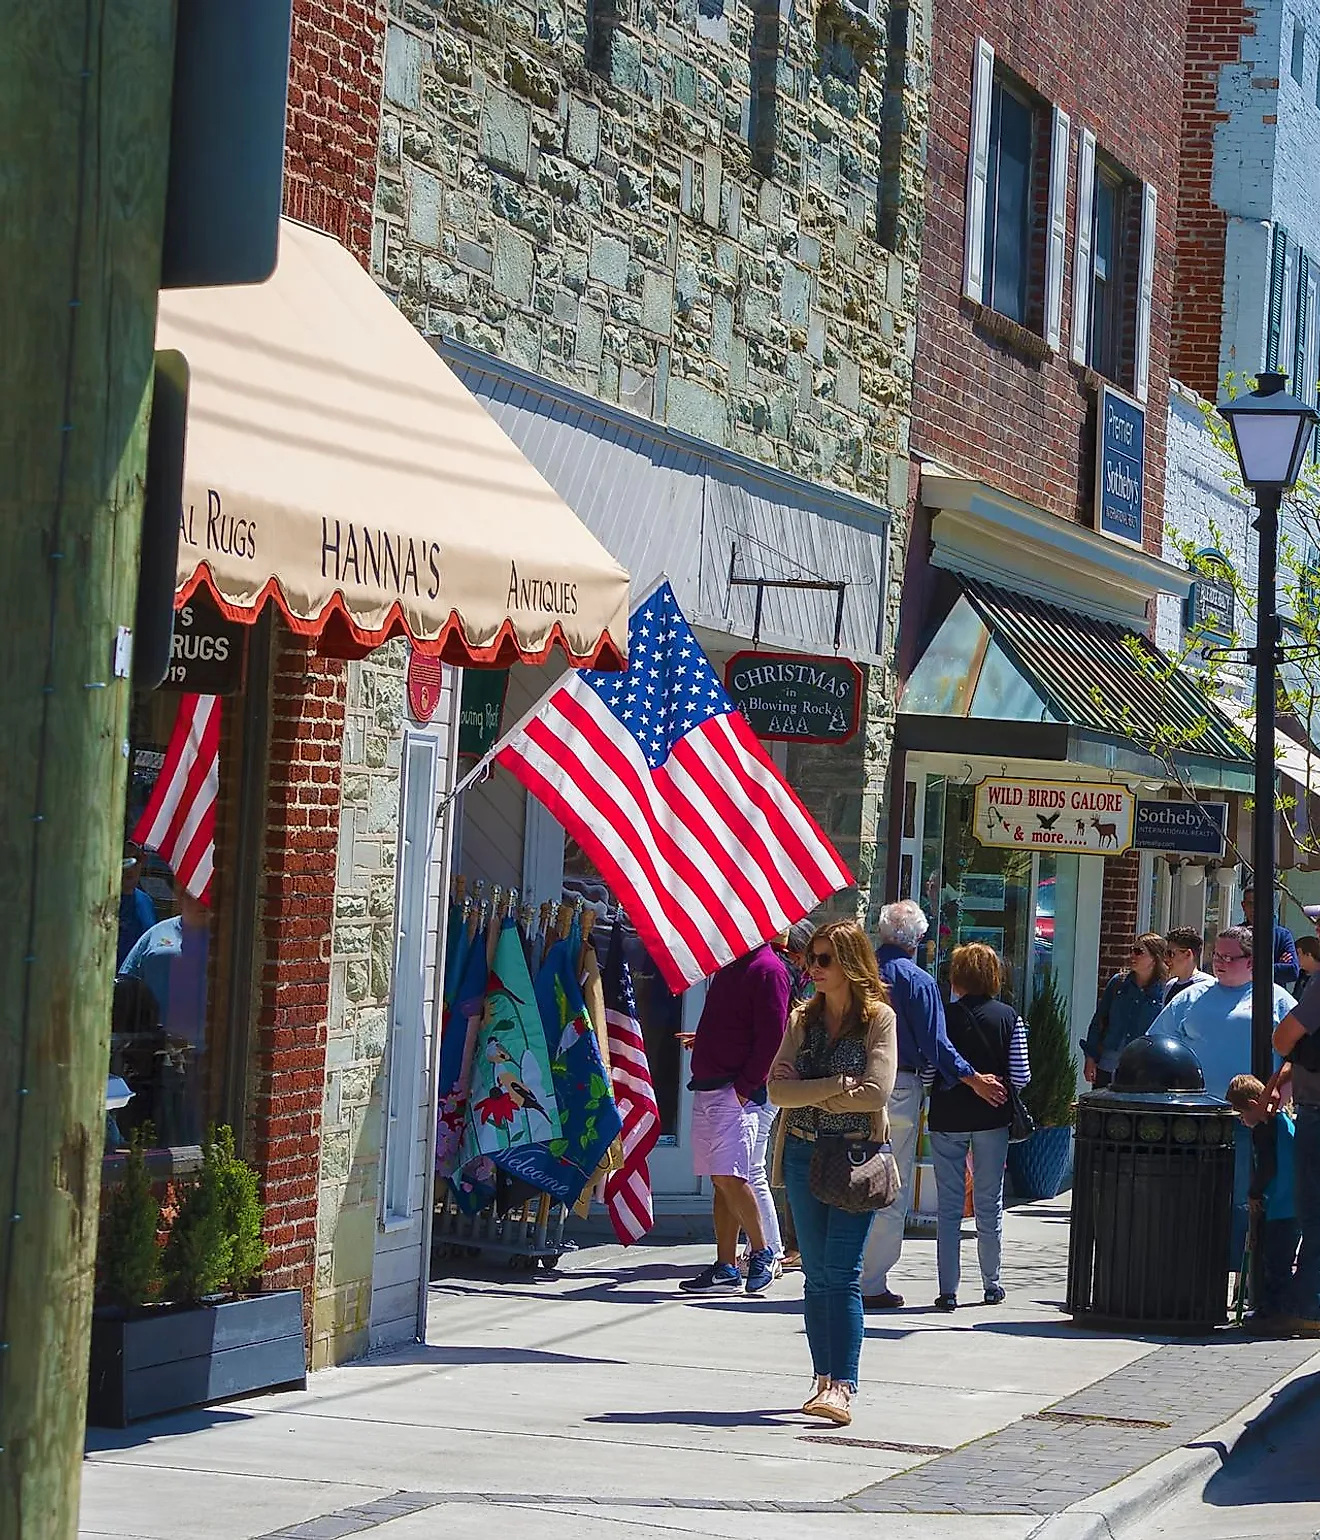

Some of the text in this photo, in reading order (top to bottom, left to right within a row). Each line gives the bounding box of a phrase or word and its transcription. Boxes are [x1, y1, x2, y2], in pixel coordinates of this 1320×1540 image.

[1107, 404, 1134, 447] Premier
[1106, 460, 1139, 511] Sotheby's
[320, 515, 441, 600] HANNA'S
[172, 633, 230, 661] RUGS
[734, 663, 850, 699] CHRISTMAS
[785, 687, 797, 698] in
[748, 697, 832, 715] Blowing Rock
[988, 786, 1122, 812] WILD BIRDS GALORE
[1013, 826, 1025, 842] &
[495, 1147, 570, 1196] Welcome
